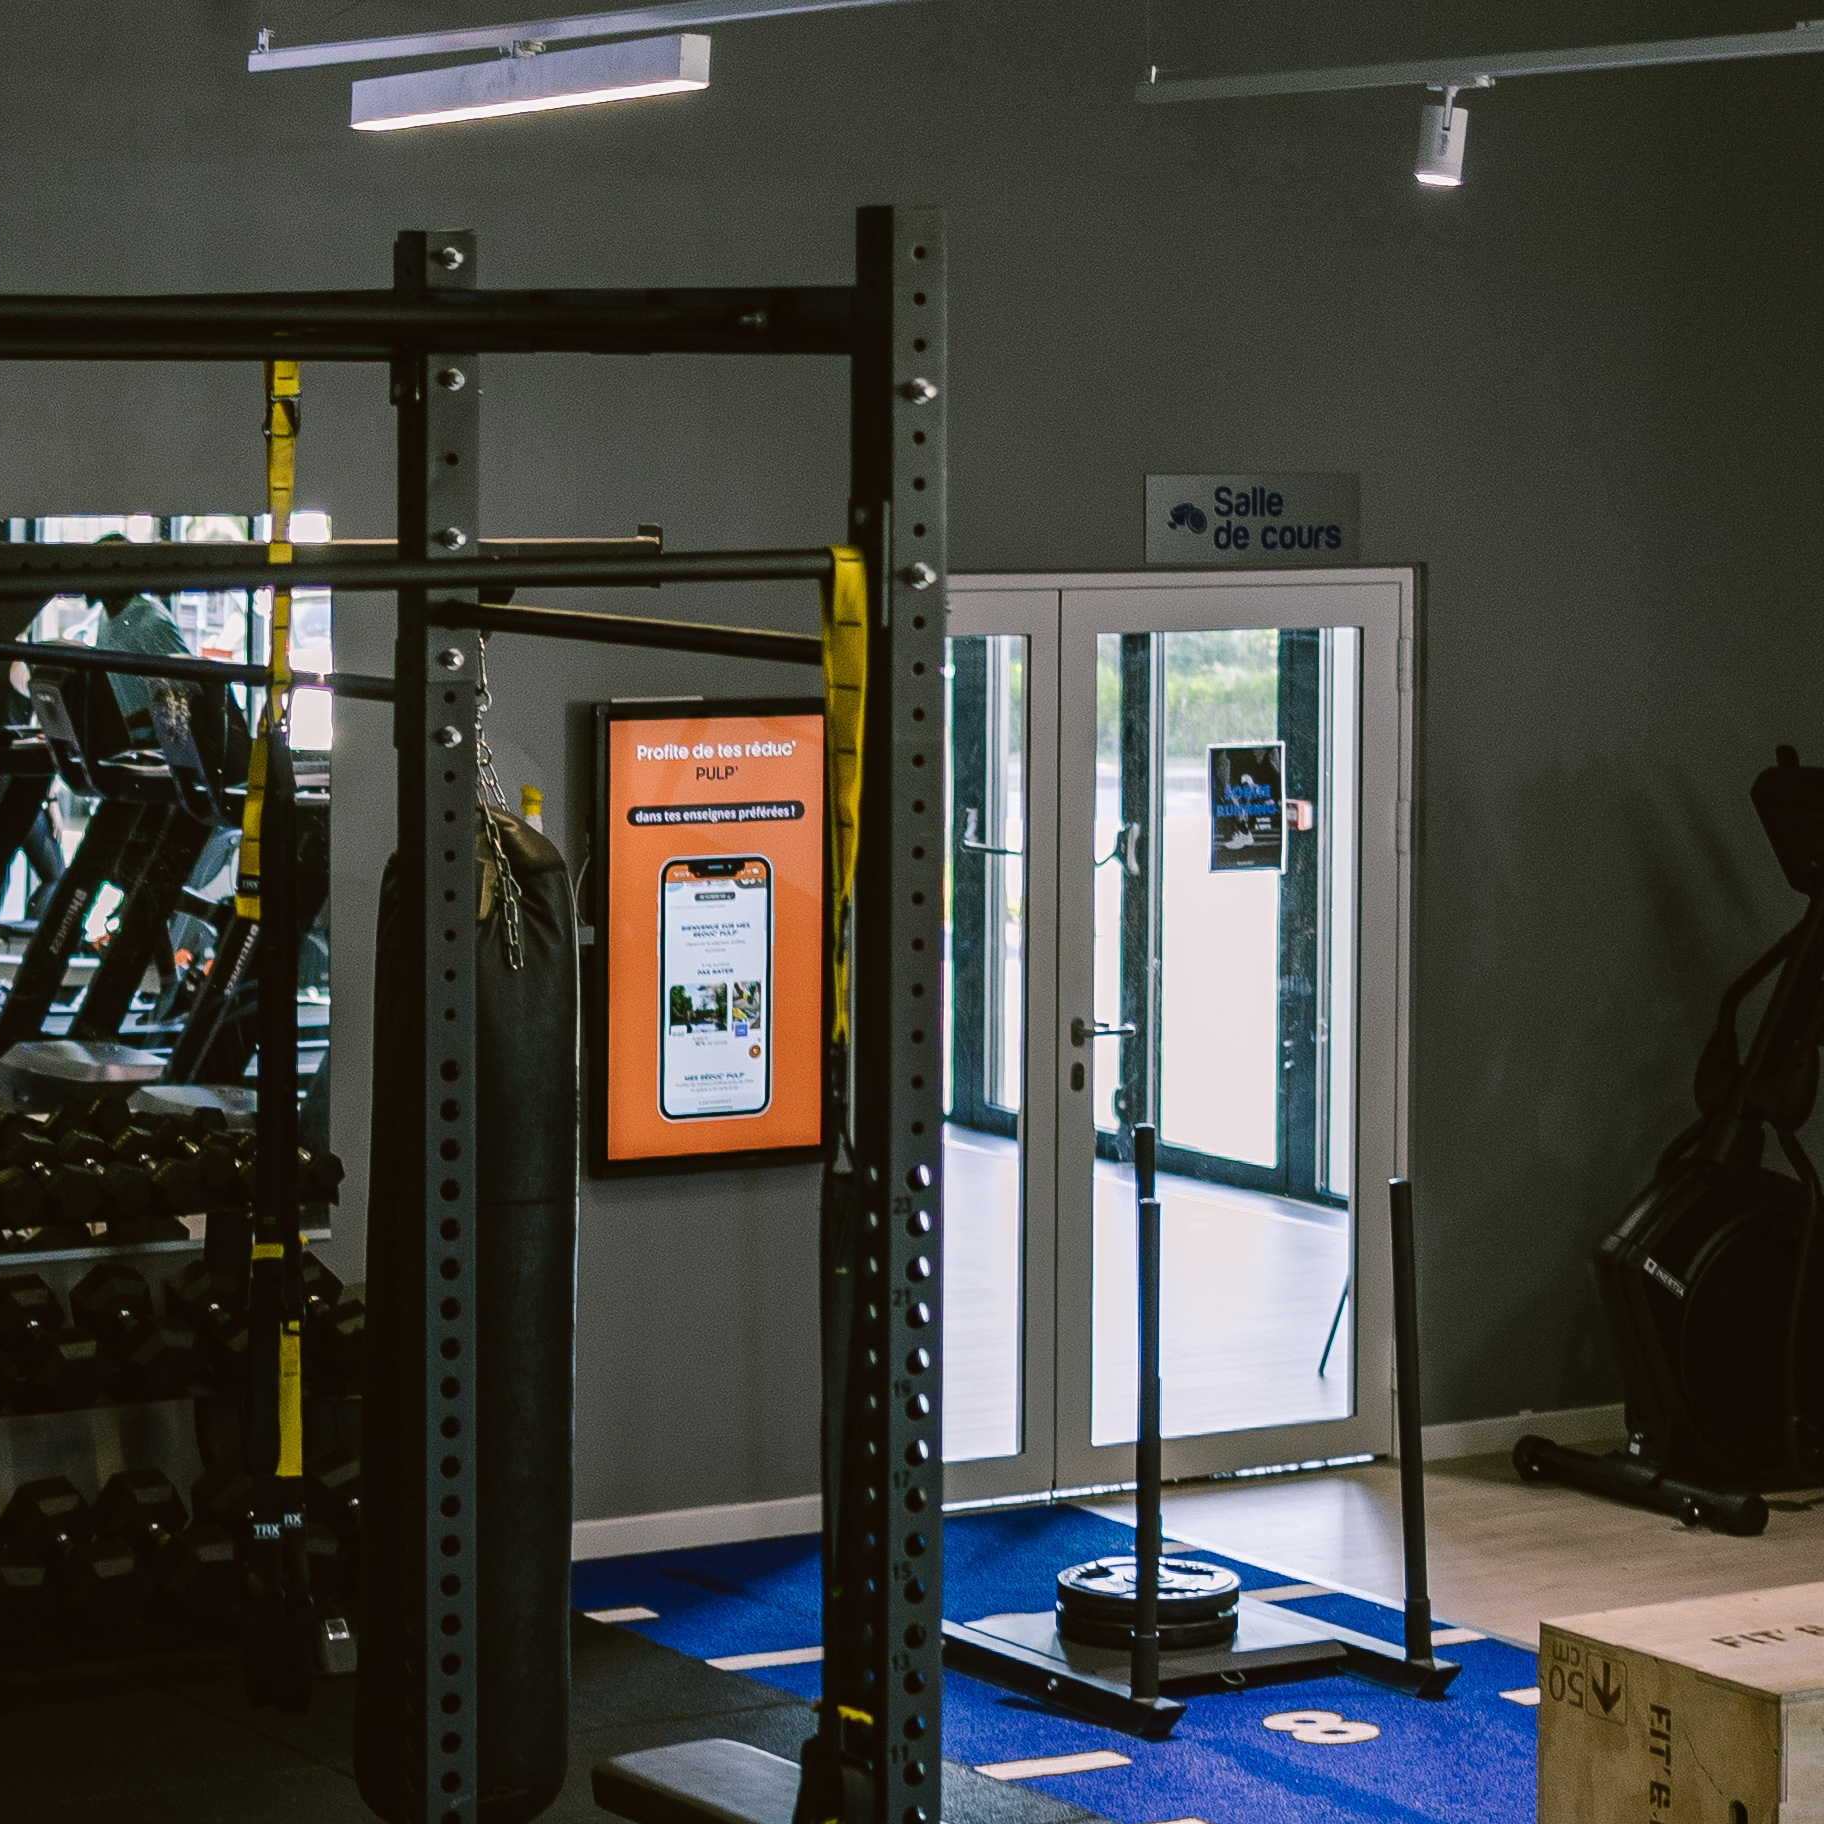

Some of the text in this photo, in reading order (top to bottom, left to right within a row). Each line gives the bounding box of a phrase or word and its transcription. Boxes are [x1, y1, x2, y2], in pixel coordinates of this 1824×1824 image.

[1213, 486, 1284, 517] Salle
[1213, 520, 1342, 550] de cours
[636, 743, 690, 762] Profite
[692, 743, 715, 760] de
[717, 742, 742, 759] tes
[635, 810, 662, 824] dans
[664, 809, 682, 823] tes
[683, 807, 737, 824] enseignes
[738, 804, 790, 823] préférées
[1549, 1665, 1584, 1709] 50
[1262, 1710, 1380, 1745] 8
